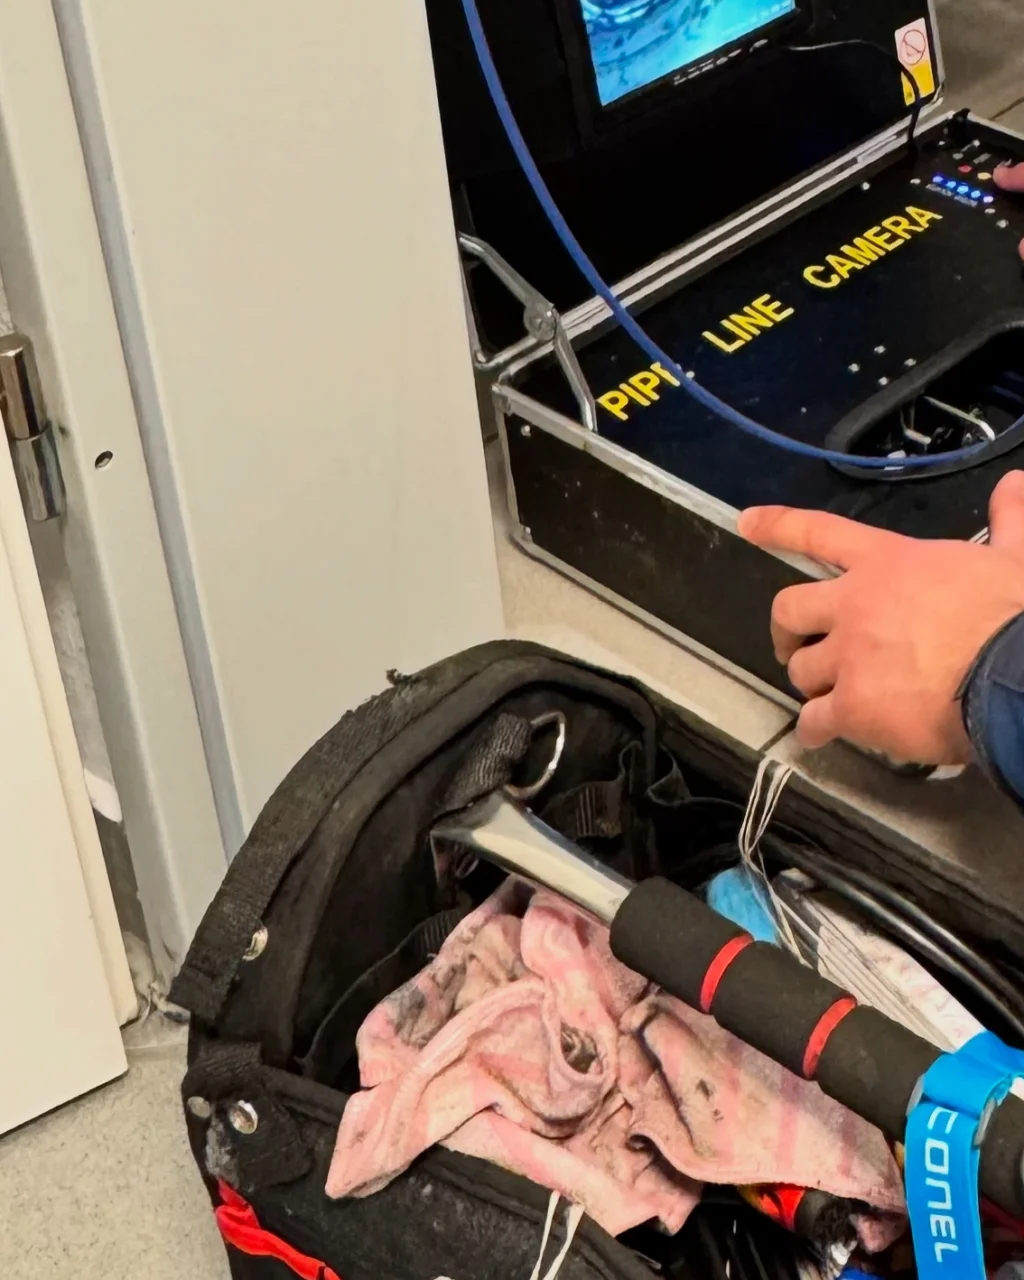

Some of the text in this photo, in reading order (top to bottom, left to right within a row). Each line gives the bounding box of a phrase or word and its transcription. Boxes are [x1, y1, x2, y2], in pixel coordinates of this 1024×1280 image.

[702, 293, 794, 353] LINE
[803, 206, 943, 289] CAMERA
[925, 1106, 959, 1263] CONEL
